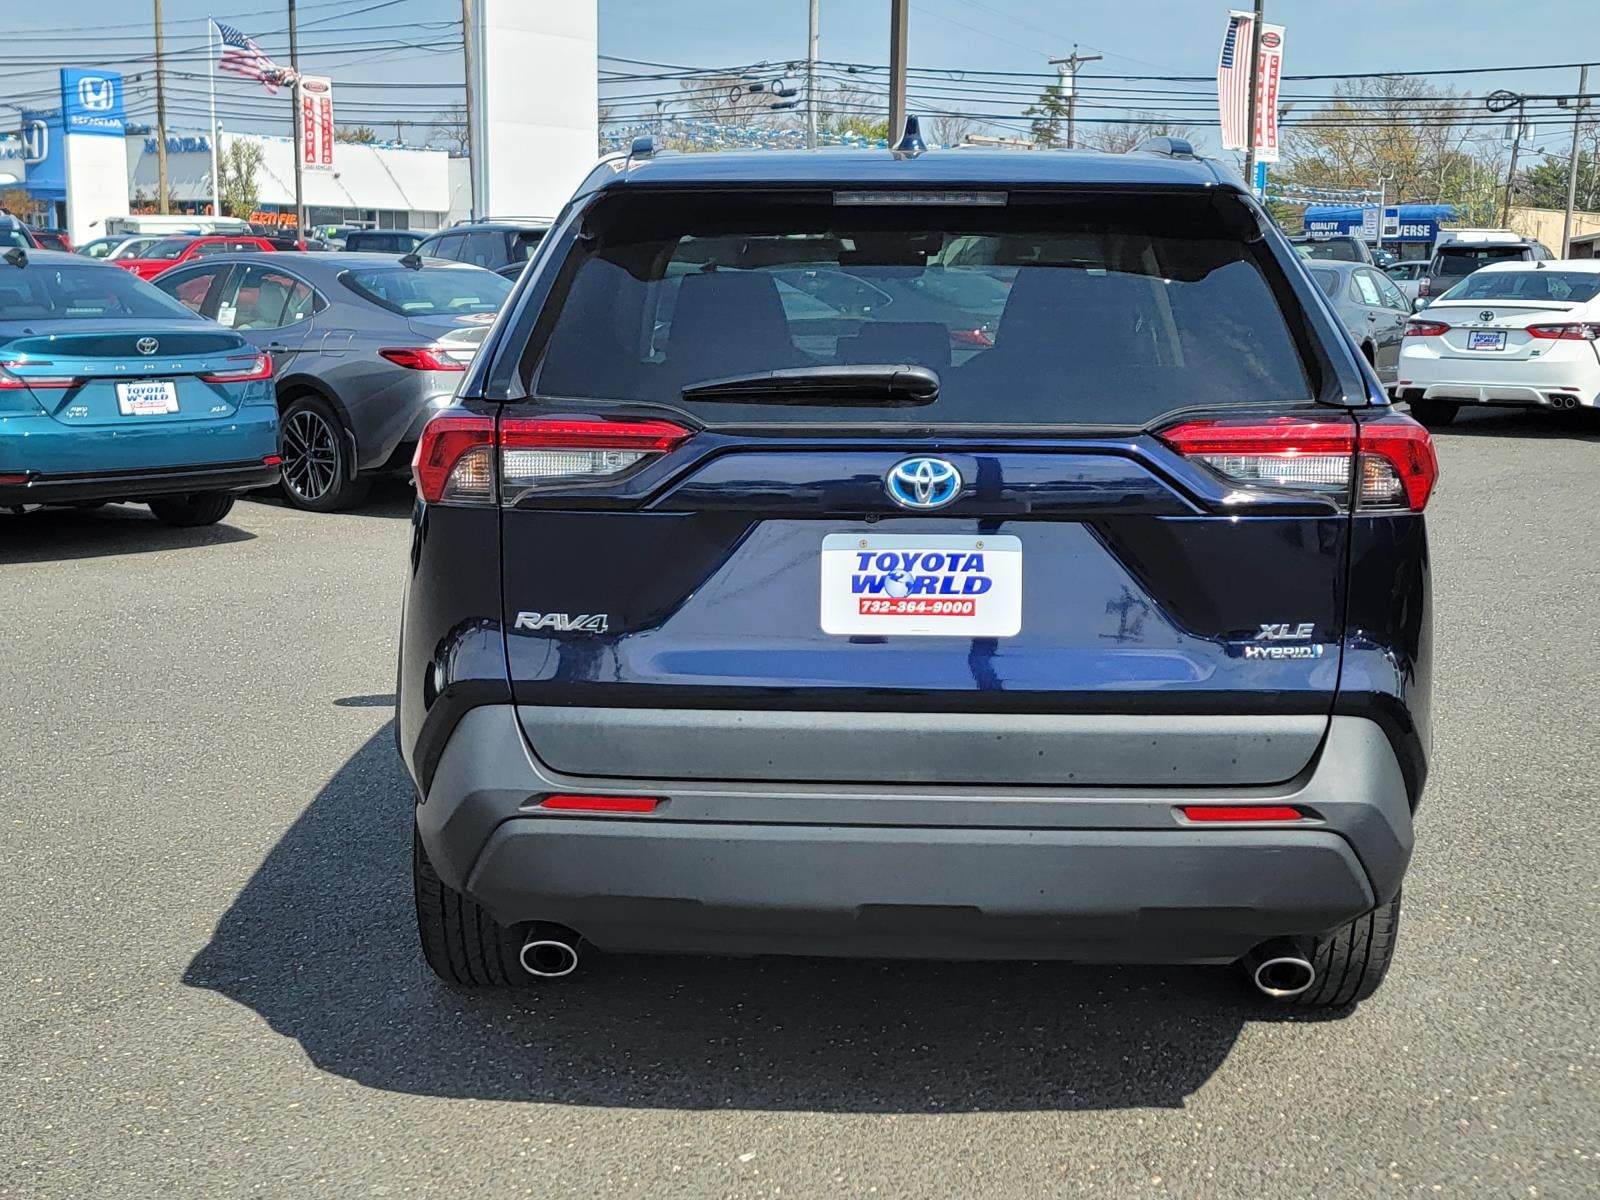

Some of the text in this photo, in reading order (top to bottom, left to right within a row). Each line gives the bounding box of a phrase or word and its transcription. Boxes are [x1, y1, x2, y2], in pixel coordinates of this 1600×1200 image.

[1268, 57, 1279, 146] CERTIFIED
[304, 98, 314, 161] TOYOTA
[143, 137, 209, 153] HNDA
[1310, 222, 1339, 230] QUALITY
[127, 387, 166, 395] TOYOTA
[856, 552, 985, 572] TOYOTA
[851, 574, 993, 598] WORLD
[860, 600, 973, 614] 732-364-9000
[514, 611, 609, 634] RAV4
[1254, 623, 1315, 640] XLE
[1244, 646, 1313, 659] HYBRID
